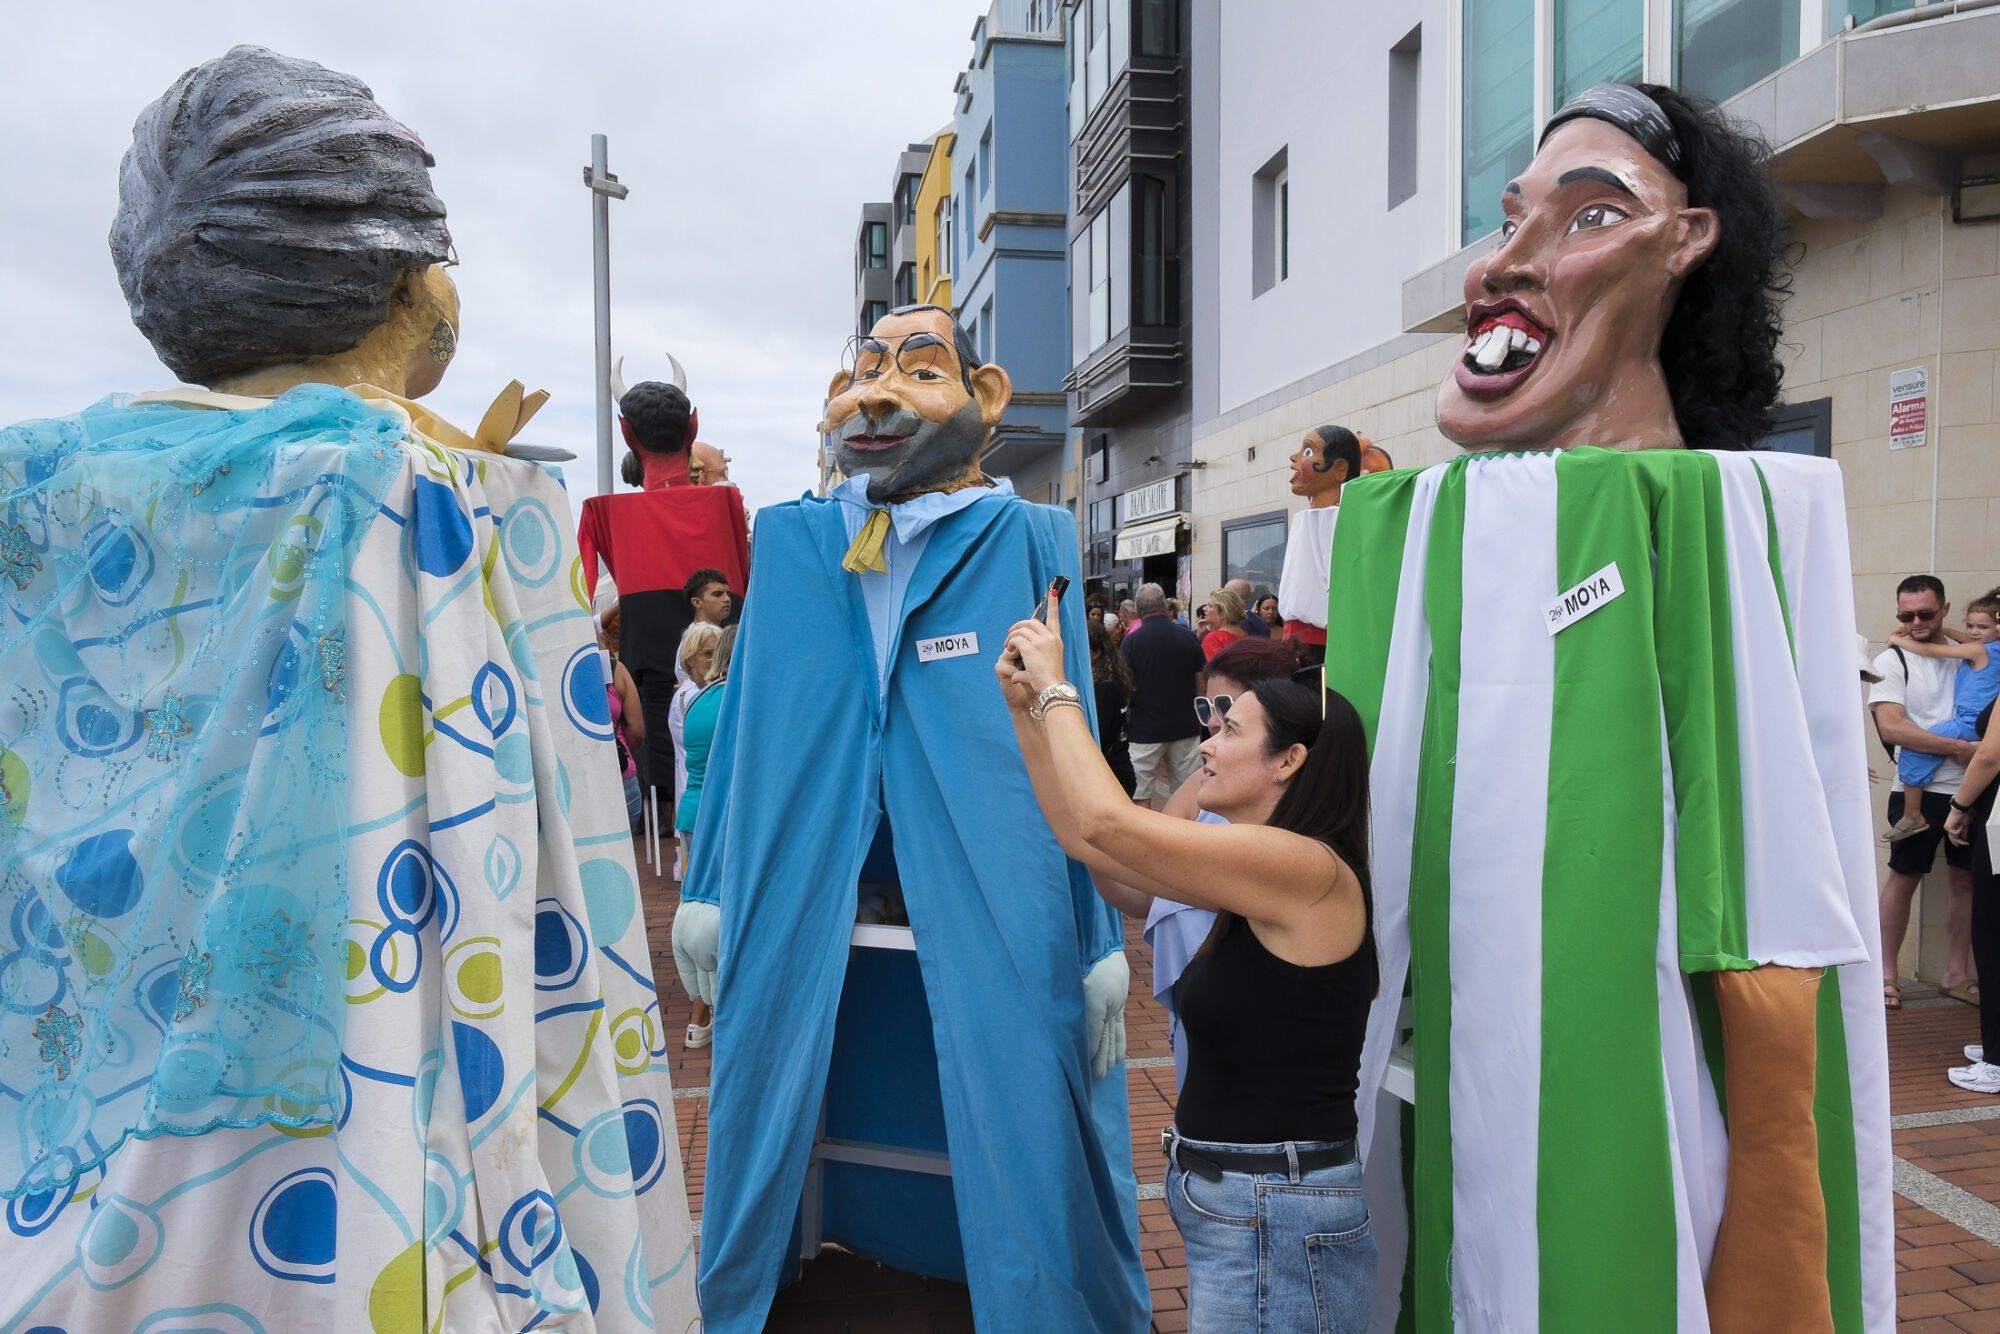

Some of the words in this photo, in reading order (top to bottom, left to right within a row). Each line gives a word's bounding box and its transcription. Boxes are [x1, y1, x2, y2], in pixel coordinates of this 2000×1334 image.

[1892, 401, 1925, 415] Alarma
[1130, 489, 1147, 517] BAZAR
[1564, 577, 1611, 616] MOYA
[935, 637, 969, 653] MOYA
